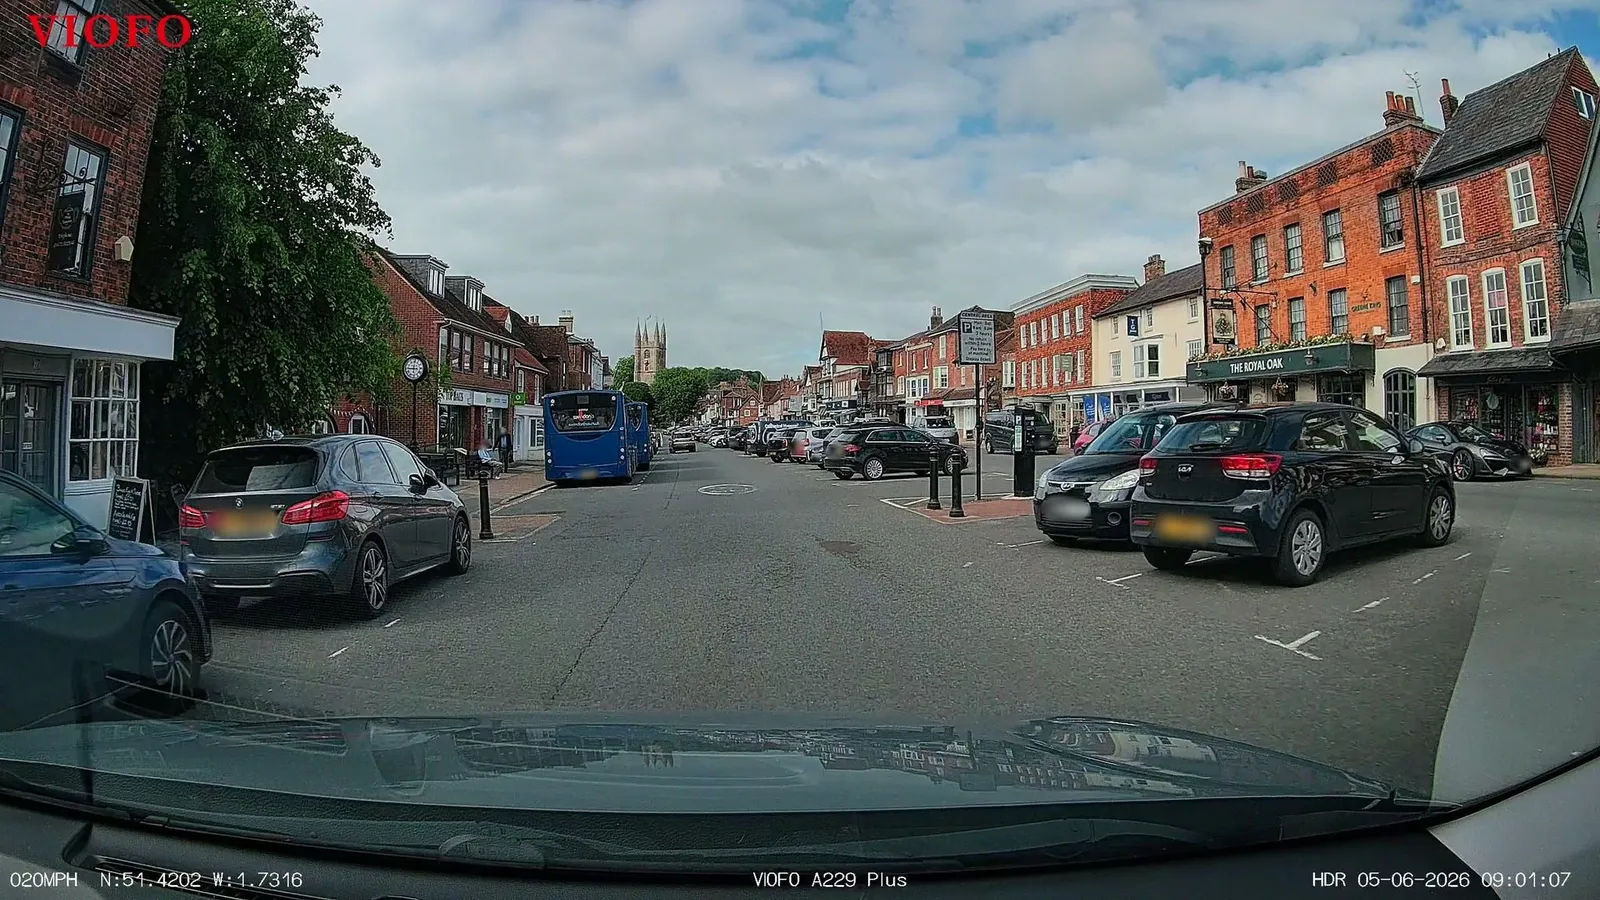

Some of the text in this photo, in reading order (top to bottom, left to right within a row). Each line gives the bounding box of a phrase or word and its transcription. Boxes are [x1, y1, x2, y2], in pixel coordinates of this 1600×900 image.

[964, 322, 971, 332] P
[1230, 358, 1284, 374] THE ROYAL OAK
[1015, 415, 1022, 425] P
